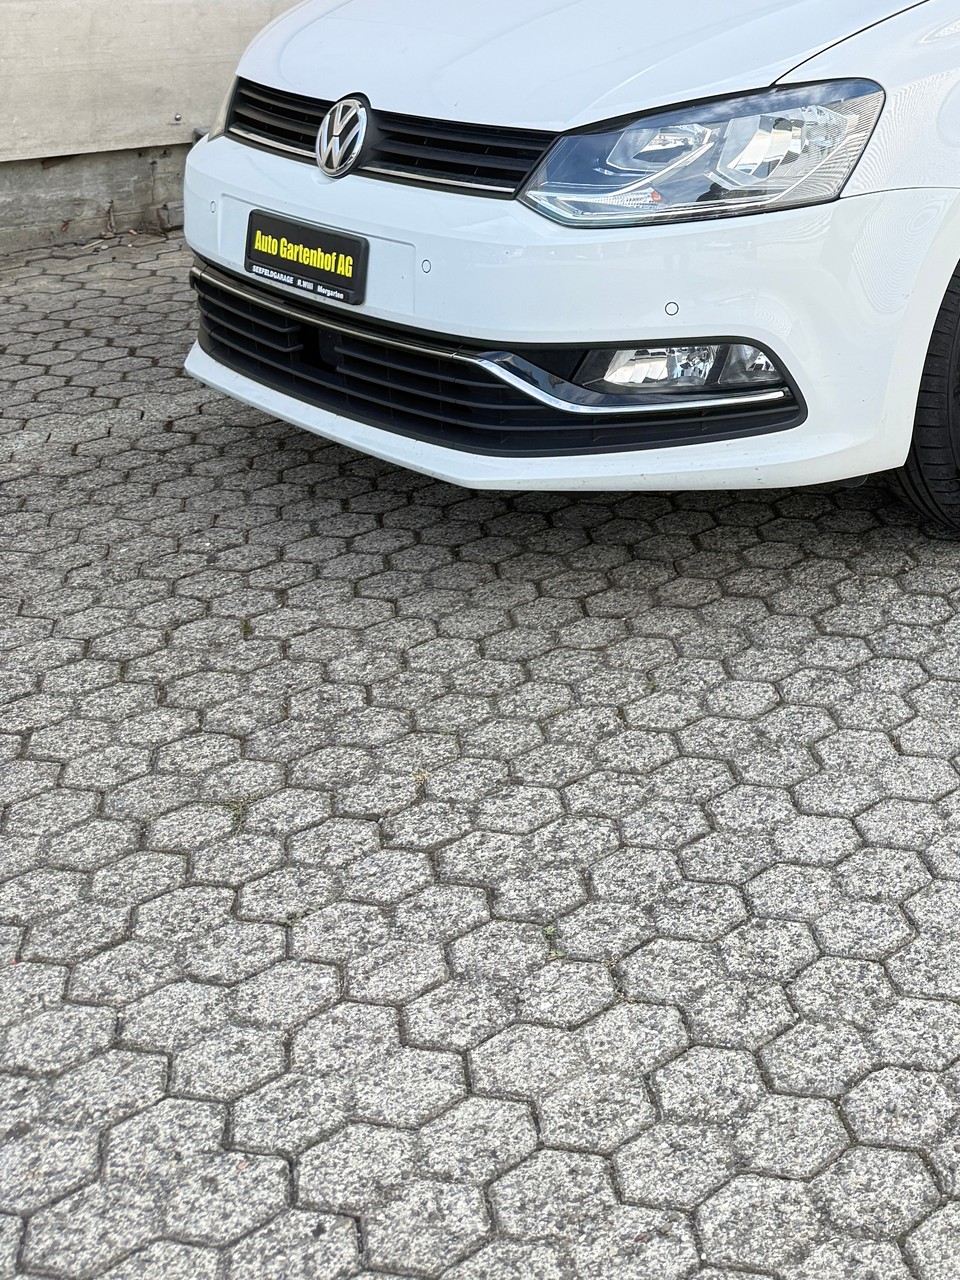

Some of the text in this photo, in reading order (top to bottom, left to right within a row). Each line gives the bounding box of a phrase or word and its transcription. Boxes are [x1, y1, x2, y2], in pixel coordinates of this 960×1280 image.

[254, 230, 354, 278] Auto Gartenhof AG
[252, 265, 294, 284] SEEFELDGARAGE
[317, 285, 344, 300] Morgarten
